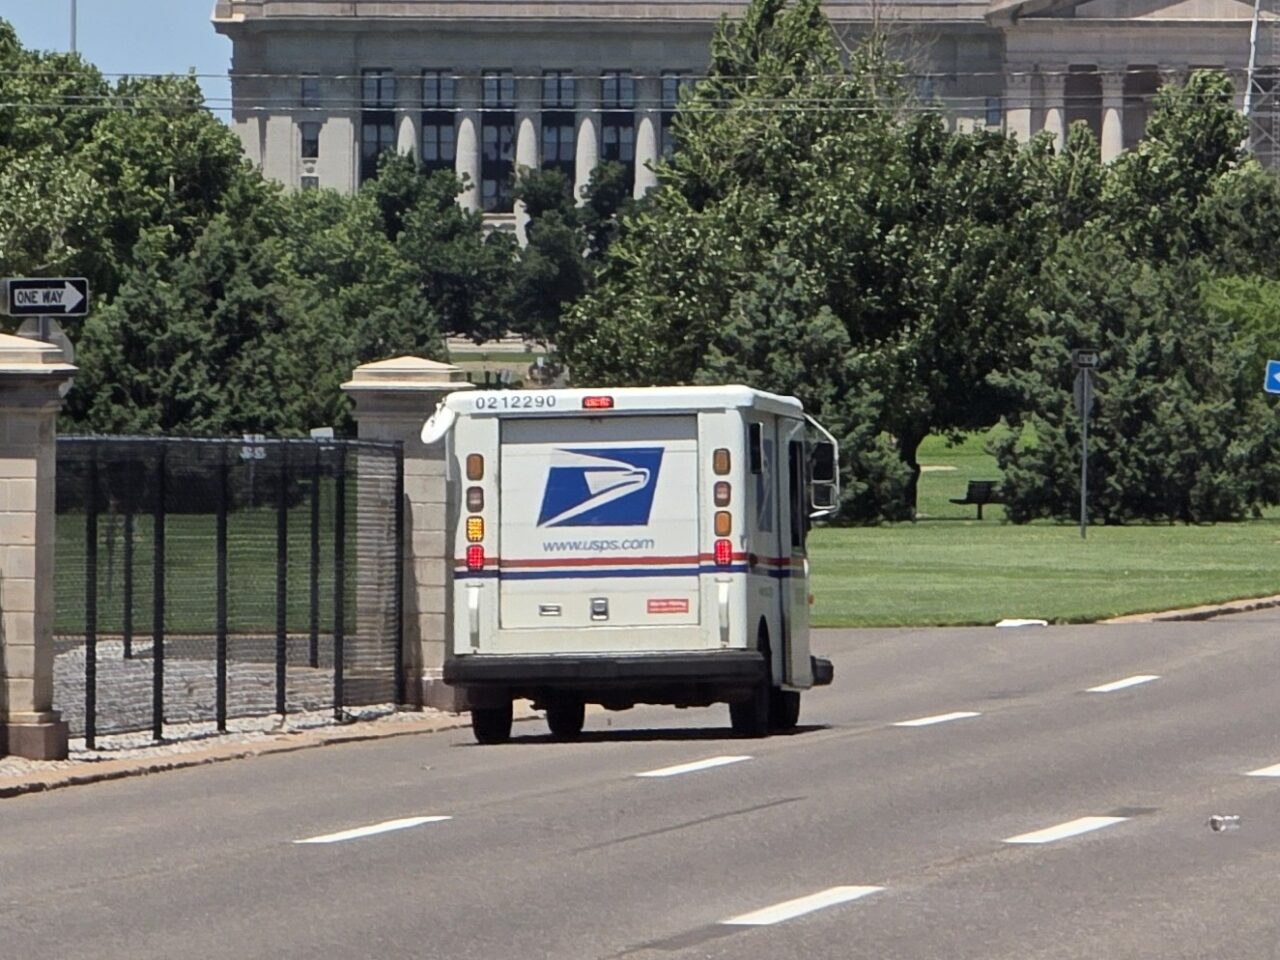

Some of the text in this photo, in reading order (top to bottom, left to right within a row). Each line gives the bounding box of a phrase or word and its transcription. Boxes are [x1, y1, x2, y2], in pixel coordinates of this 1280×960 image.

[16, 290, 64, 304] ONE WAY
[475, 395, 557, 410] 0212290
[542, 538, 655, 553] www.usps.com
